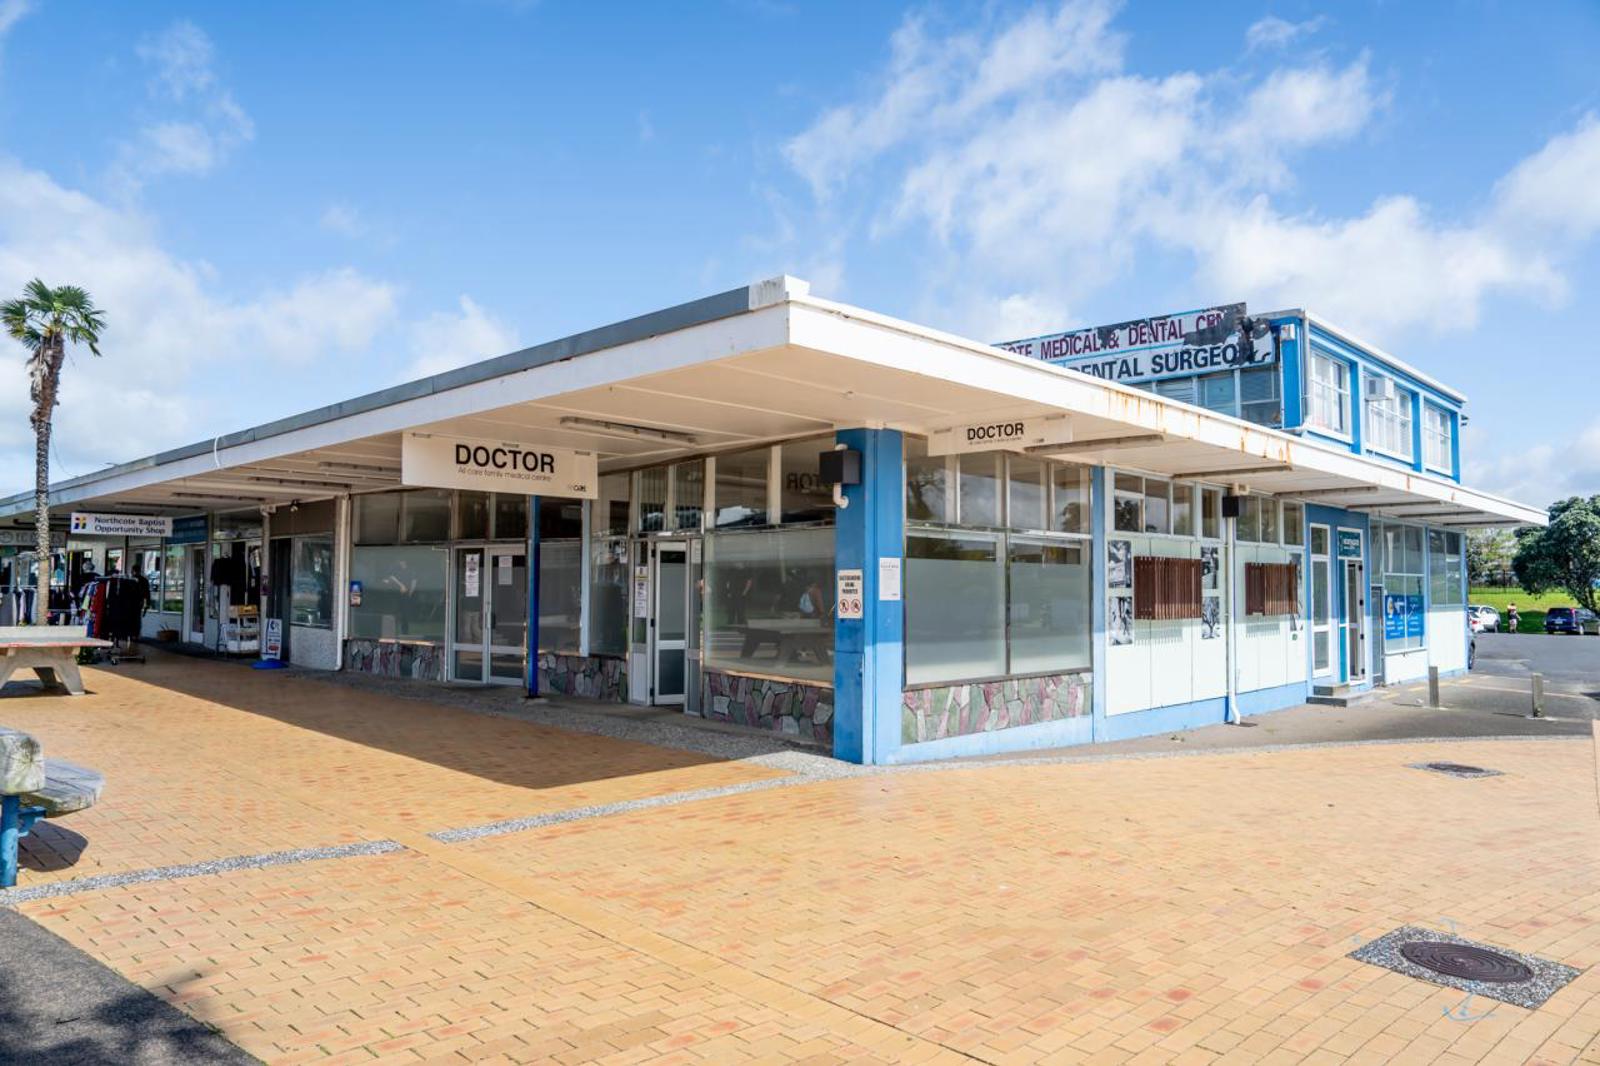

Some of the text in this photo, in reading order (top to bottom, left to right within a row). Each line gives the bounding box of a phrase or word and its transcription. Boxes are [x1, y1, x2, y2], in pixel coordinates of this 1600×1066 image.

[1040, 333, 1101, 360] MEDICAL
[1107, 331, 1119, 349] &
[1128, 319, 1185, 346] DENTAL
[1067, 343, 1237, 379] ENTAL SURGEO
[967, 422, 1024, 441] DOCTOR
[455, 443, 555, 473] DOCTOR
[504, 471, 530, 479] medical
[94, 516, 165, 526] Northcote Baptist
[94, 524, 165, 534] Opportunity Shop
